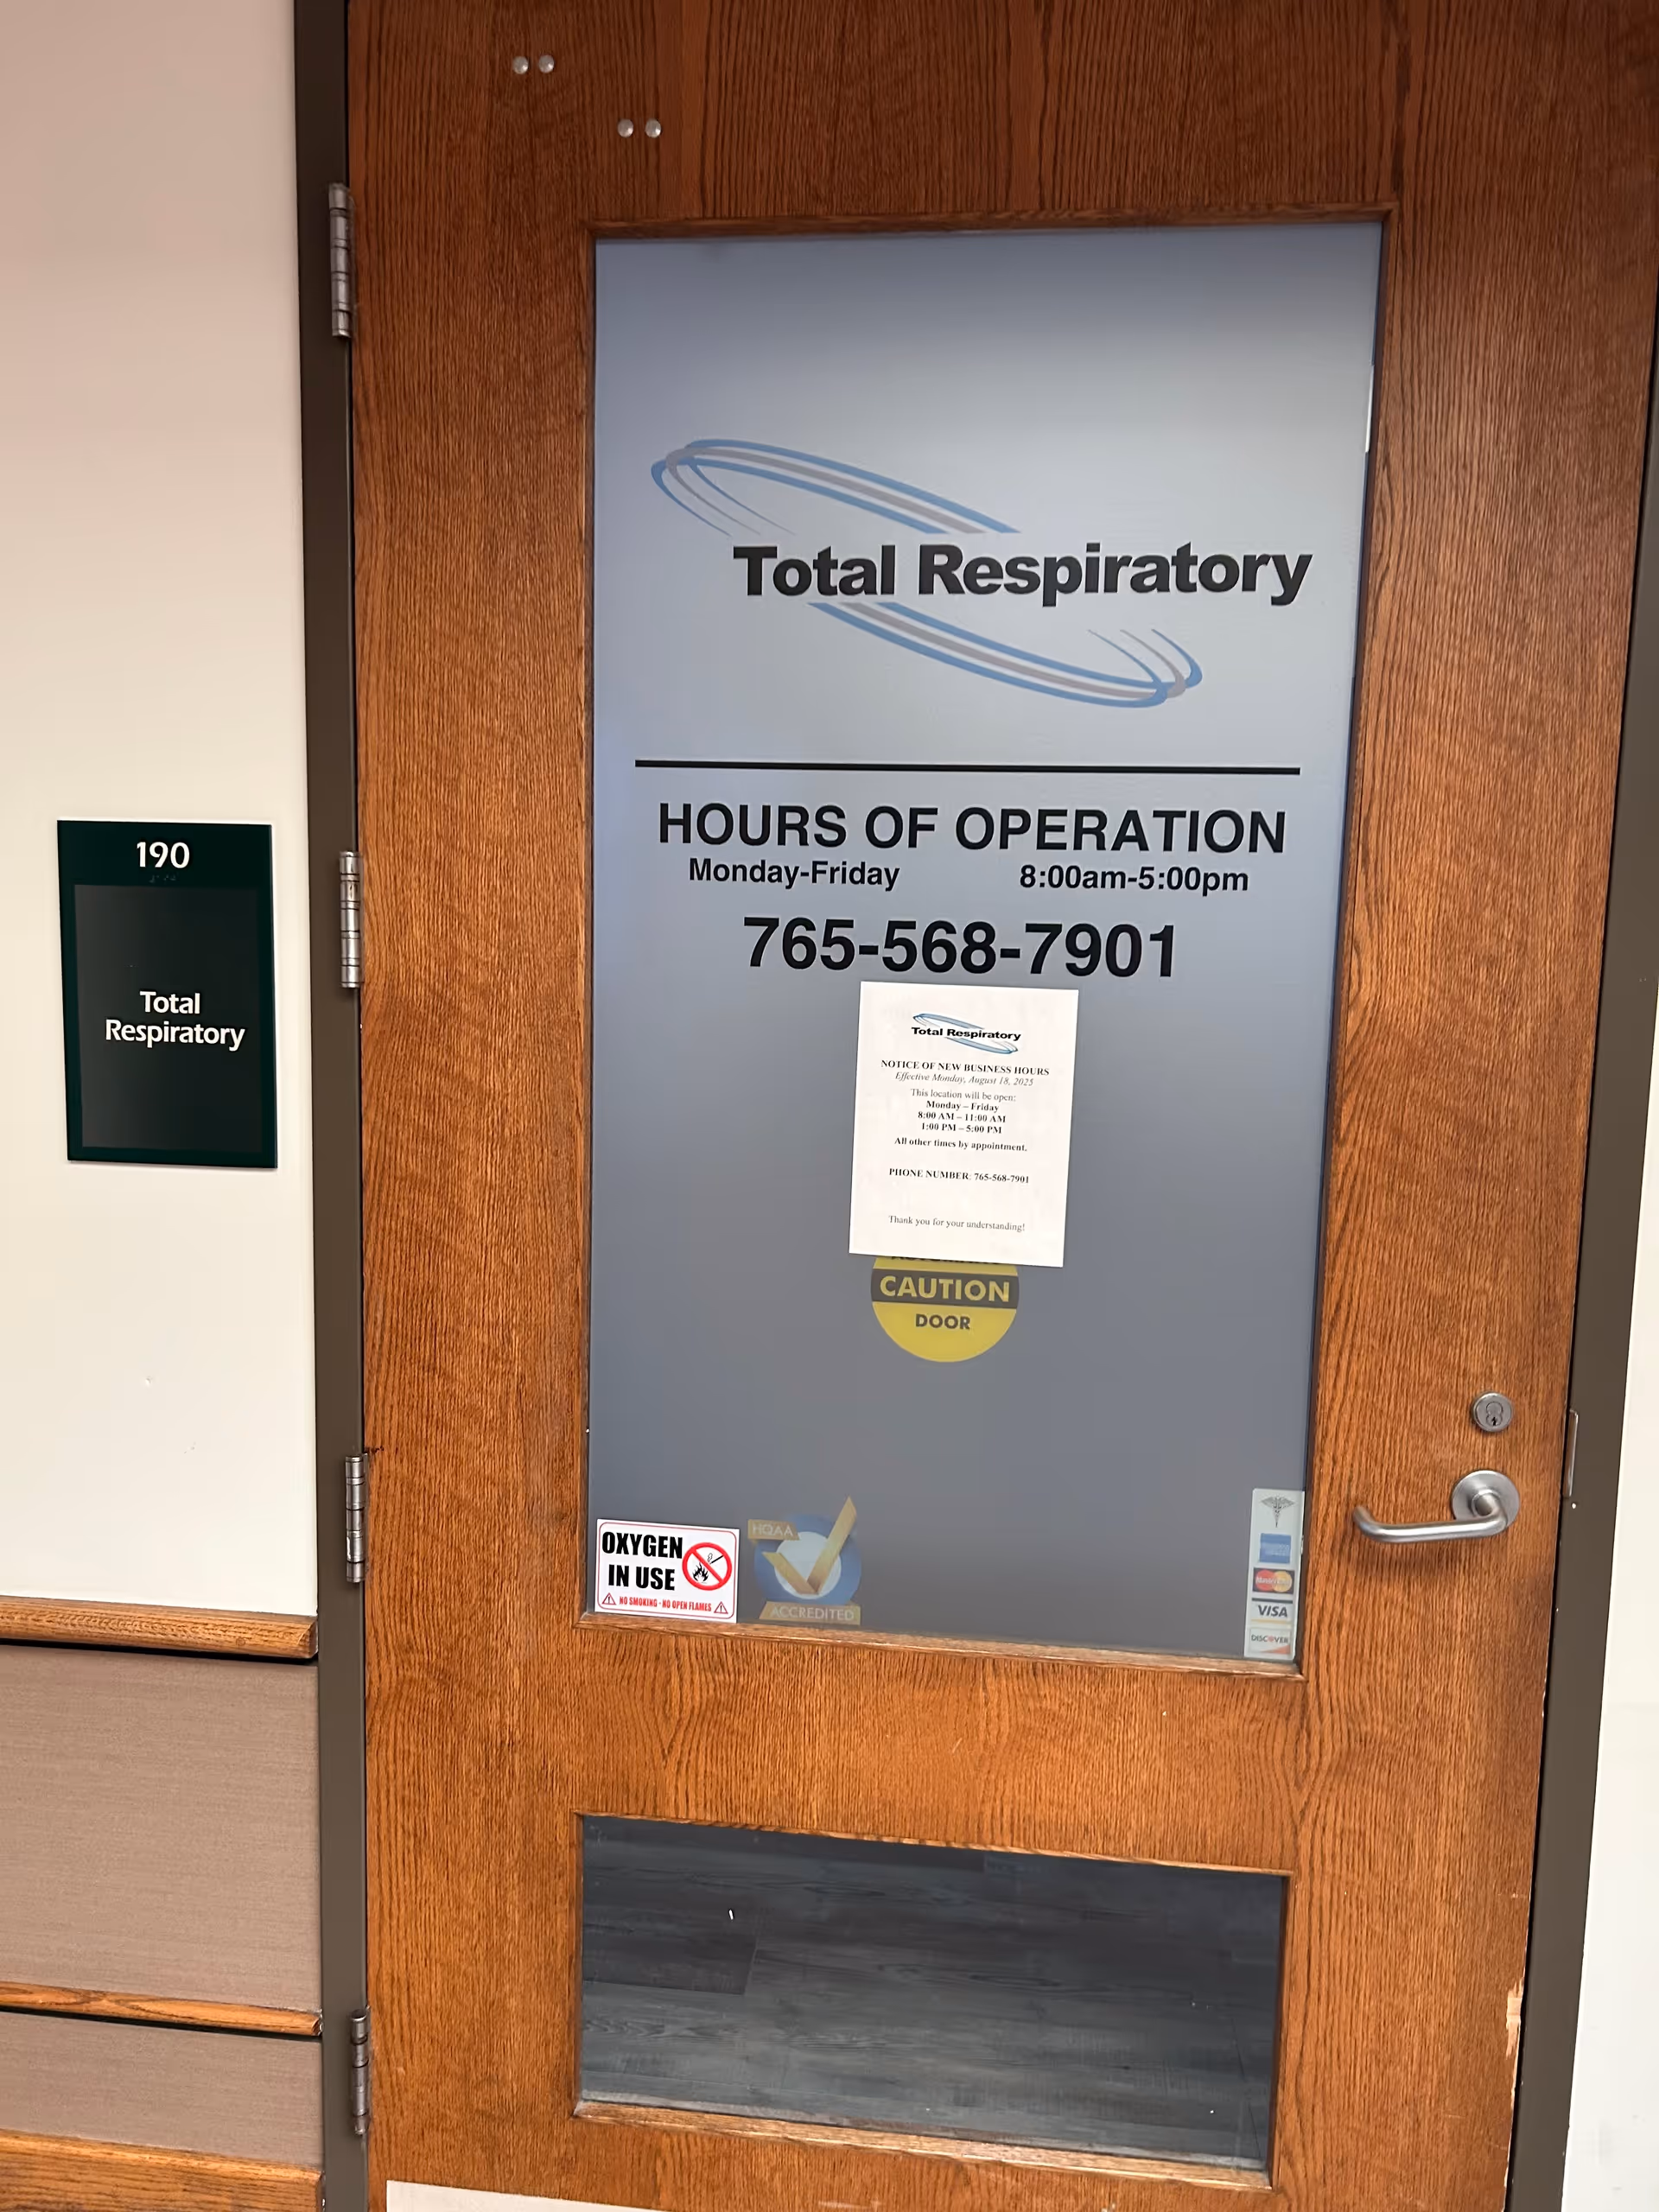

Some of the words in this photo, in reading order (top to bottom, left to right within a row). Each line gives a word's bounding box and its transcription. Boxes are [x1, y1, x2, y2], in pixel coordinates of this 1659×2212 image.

[733, 544, 894, 598] Total
[918, 541, 1313, 607] Respiratory
[658, 802, 847, 848] HOURS
[865, 806, 938, 849] OF
[956, 808, 1286, 854] OPERATION
[136, 841, 191, 868] 190
[690, 857, 900, 893] Monday-Friday
[1019, 865, 1249, 896] 8:00am-5:00pm
[743, 916, 1175, 978] 765-568-7901
[139, 990, 200, 1014] Total
[105, 1018, 245, 1052] Respiratory
[911, 1027, 943, 1036] Total
[946, 1028, 1021, 1041] Respiratory
[880, 1059, 919, 1070] NOTICE
[922, 1061, 936, 1070] OF
[938, 1062, 962, 1071] NEW
[963, 1064, 1012, 1074] BUSINESS
[1014, 1066, 1050, 1076] HOURS
[895, 1071, 930, 1082] Effective
[931, 1073, 966, 1084] Monday,
[968, 1076, 996, 1085] August
[1014, 1077, 1034, 1086] 2025
[911, 1089, 928, 1097] This
[931, 1090, 963, 1099] location
[964, 1090, 980, 1100] will
[982, 1091, 992, 1101] be
[994, 1093, 1016, 1103] open:
[926, 1100, 962, 1111] Monday
[971, 1103, 1000, 1113] Friday
[918, 1111, 937, 1120] 8:00
[938, 1112, 955, 1121] AM
[964, 1114, 988, 1122] 11:00
[989, 1115, 1007, 1123] AM
[921, 1122, 939, 1131] 1:00
[942, 1123, 957, 1132] PM
[909, 1138, 931, 1147] other
[958, 1140, 969, 1149] by
[971, 1141, 1027, 1152] appointment.
[889, 1167, 924, 1178] PHONE
[925, 1170, 972, 1180] NUMBER:
[974, 1173, 1029, 1184] 765-568-7901
[888, 1215, 913, 1224] Thank
[915, 1218, 931, 1227] you
[932, 1217, 944, 1226] for
[946, 1220, 965, 1229] your
[966, 1221, 1026, 1233] understanding!
[880, 1274, 1010, 1303] CAUTION
[915, 1313, 971, 1330] DOOR
[752, 1523, 794, 1537] HQAA
[602, 1531, 683, 1559] OXYGEN
[608, 1564, 630, 1587] IN
[635, 1566, 676, 1591] USE
[619, 1596, 628, 1605] NO
[629, 1597, 658, 1607] SMOKING
[662, 1599, 671, 1608] NO
[672, 1600, 688, 1610] OPEN
[689, 1601, 712, 1611] FLAMES
[1257, 1605, 1288, 1618] VISA
[769, 1605, 855, 1622] ACCREDITED
